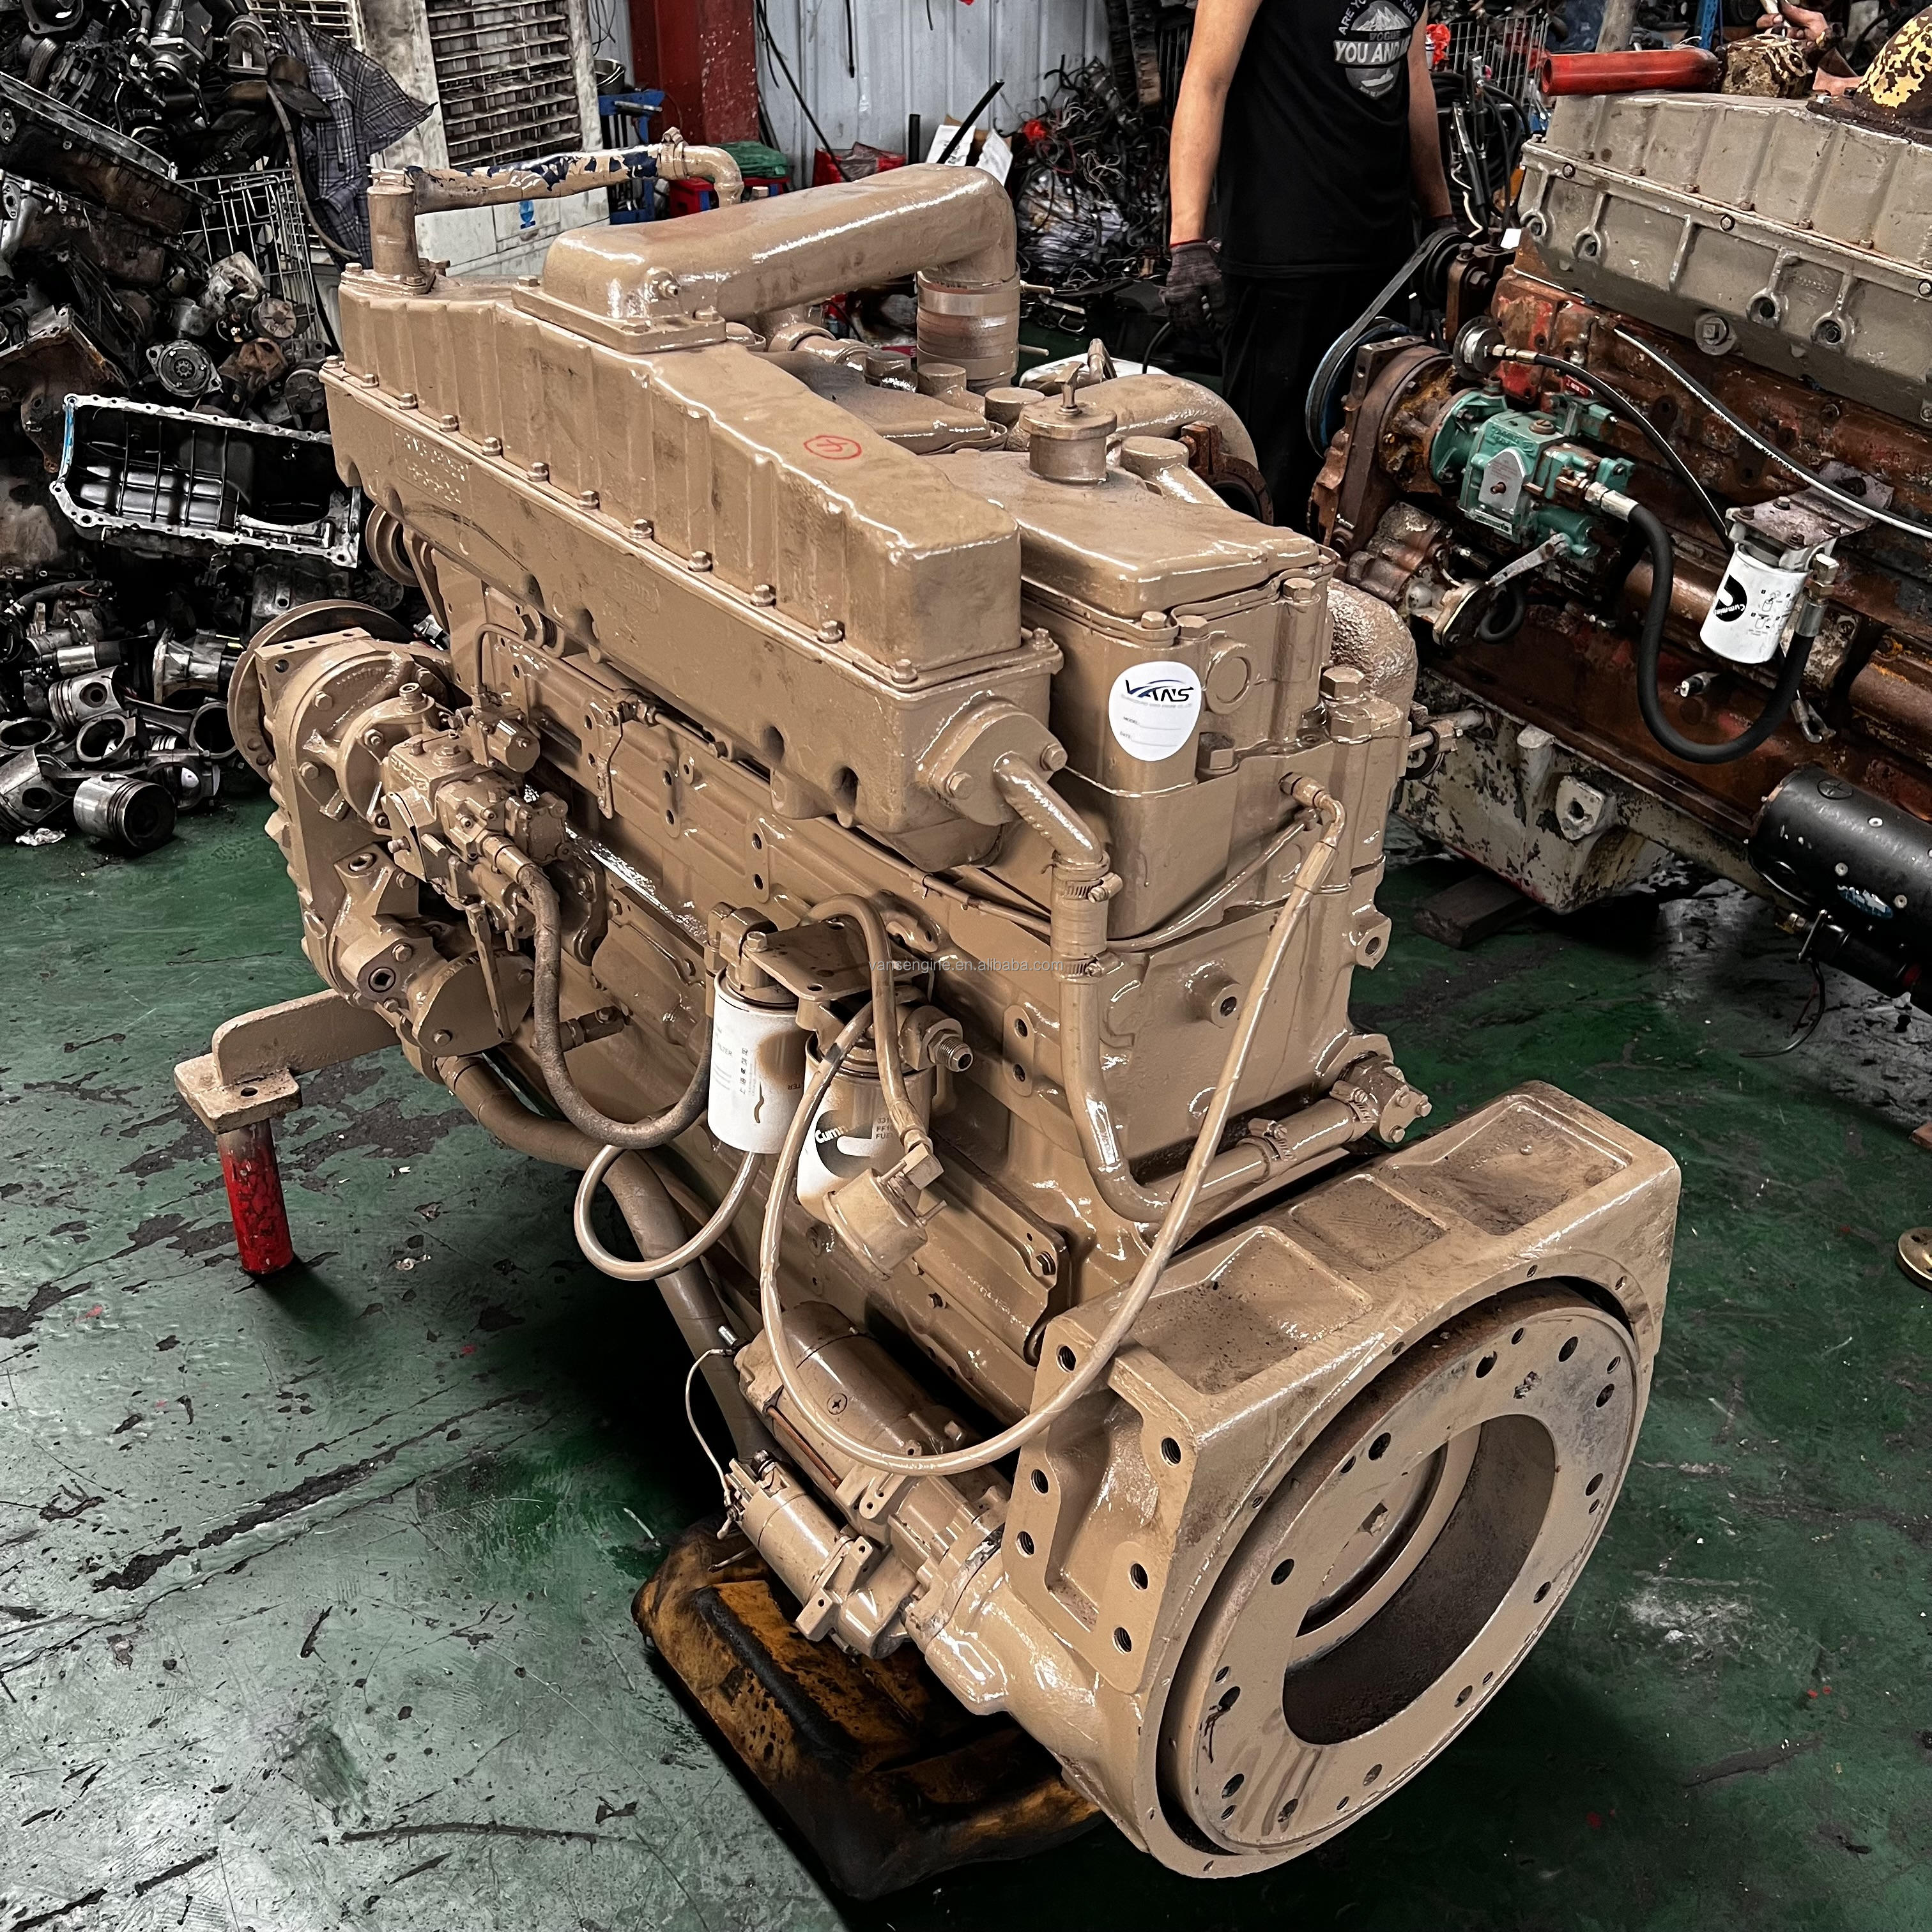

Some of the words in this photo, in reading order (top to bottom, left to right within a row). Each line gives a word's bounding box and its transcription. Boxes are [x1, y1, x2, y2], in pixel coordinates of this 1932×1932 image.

[1338, 7, 1355, 36] ARE
[1335, 41, 1368, 63] YOU
[1370, 40, 1400, 63] AND
[1124, 679, 1195, 702] VANS
